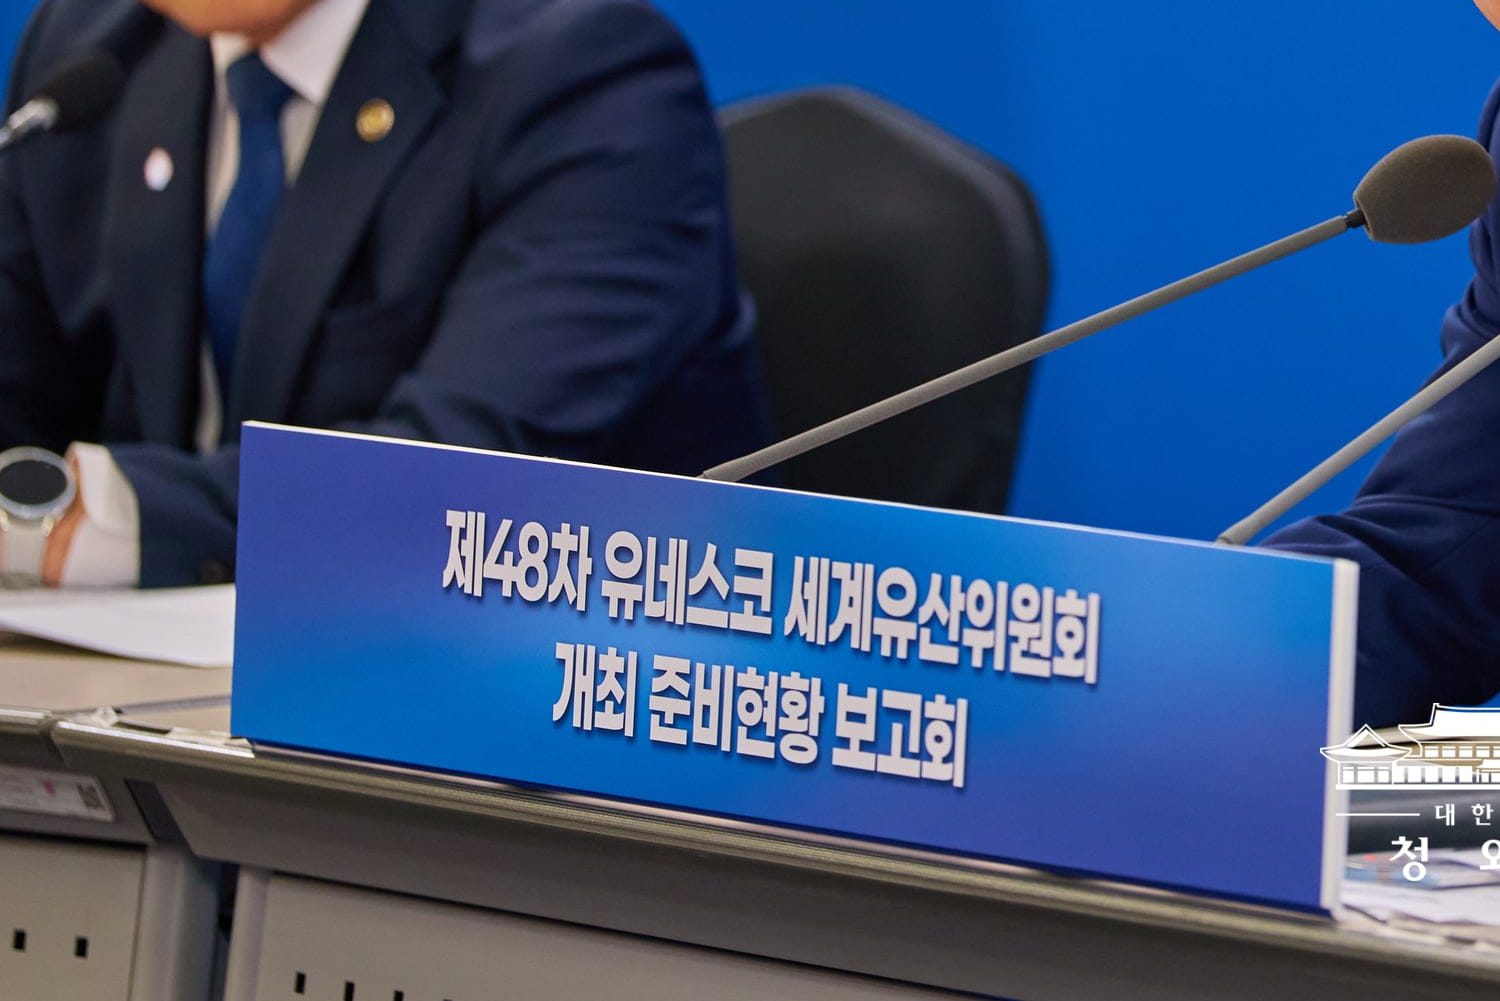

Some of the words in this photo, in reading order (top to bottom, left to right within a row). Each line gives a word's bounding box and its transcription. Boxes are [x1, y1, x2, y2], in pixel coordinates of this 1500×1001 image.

[442, 509, 593, 611] 제48차
[601, 530, 774, 634] 유네스코
[784, 556, 1100, 684] 세계유산위원회
[552, 642, 638, 737] 개최
[649, 654, 825, 764] 준비현황
[832, 683, 968, 788] 보고회
